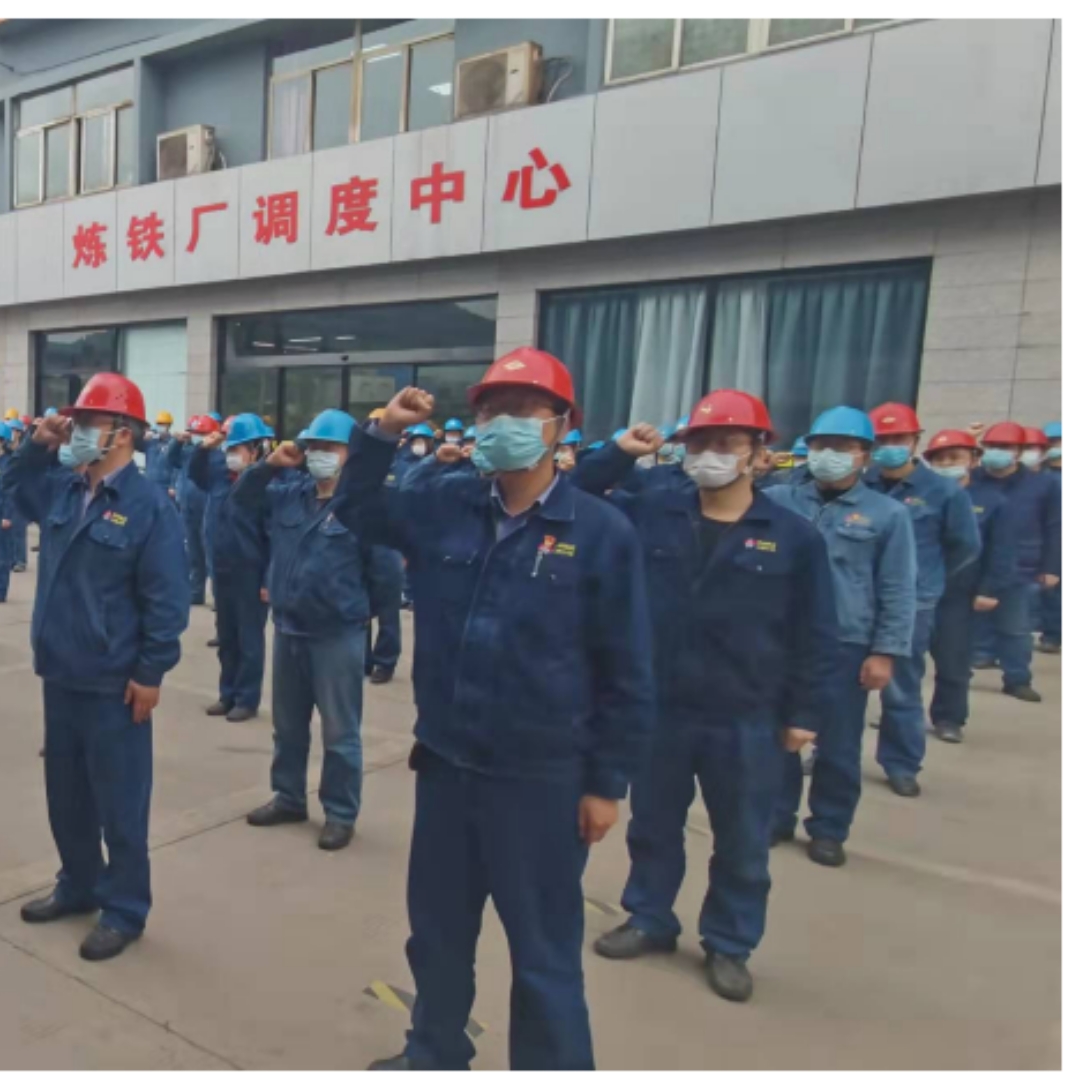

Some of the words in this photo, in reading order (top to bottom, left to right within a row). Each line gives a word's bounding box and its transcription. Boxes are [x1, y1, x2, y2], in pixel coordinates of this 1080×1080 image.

[72, 147, 572, 269] 炼铁厂调度中心
